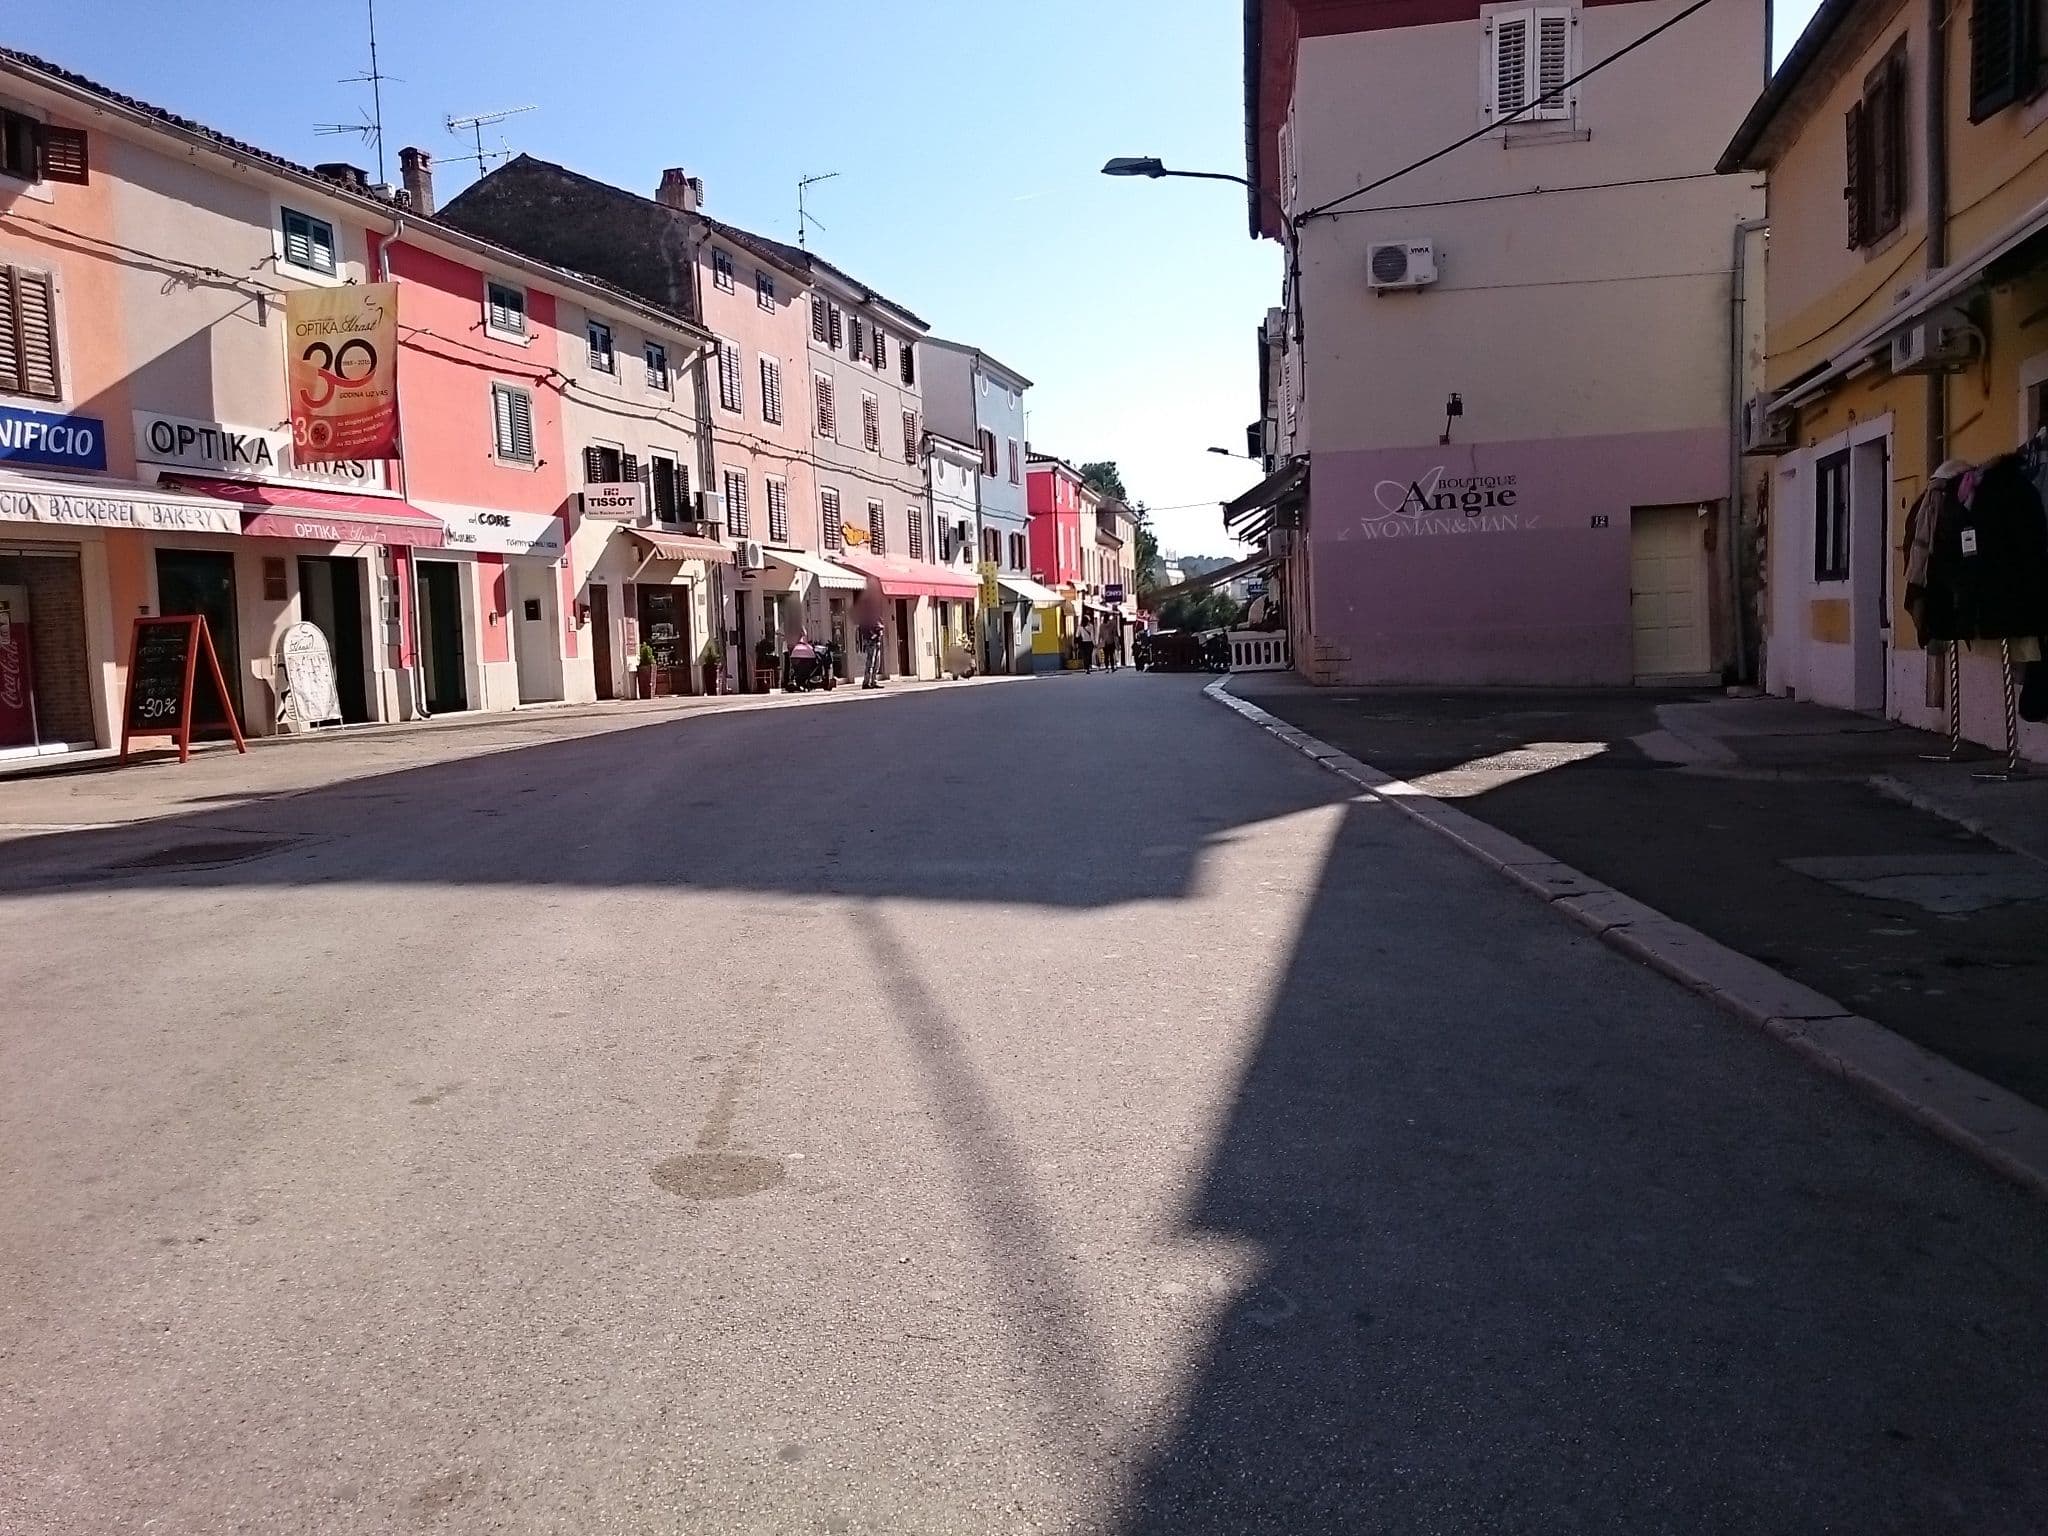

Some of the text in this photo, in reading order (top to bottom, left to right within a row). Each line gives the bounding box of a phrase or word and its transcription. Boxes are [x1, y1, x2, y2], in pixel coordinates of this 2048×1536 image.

[295, 321, 338, 337] OPTIKA
[151, 420, 274, 466] OPTIKA
[1438, 475, 1517, 489] BOUTIQUE
[588, 497, 635, 506] TISSOT
[1396, 481, 1517, 518] Angie
[478, 513, 511, 527] CORE
[295, 524, 341, 540] OPTIKA
[139, 698, 177, 718] -30%
